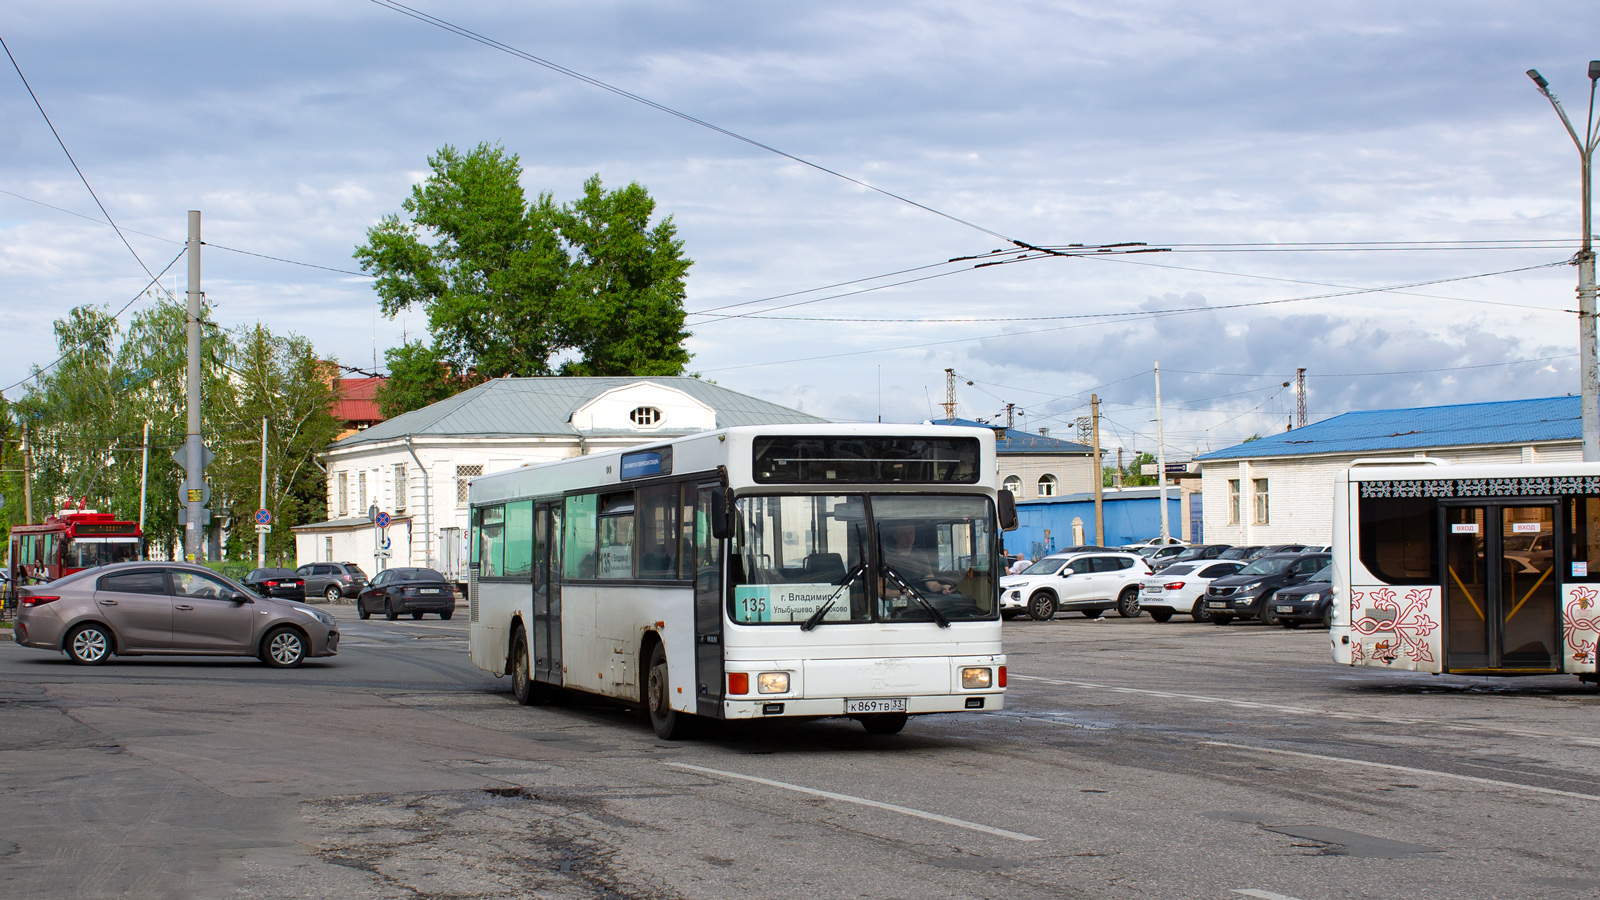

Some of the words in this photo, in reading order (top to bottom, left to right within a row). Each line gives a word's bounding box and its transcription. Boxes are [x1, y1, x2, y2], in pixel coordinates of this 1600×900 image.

[781, 594, 786, 602] г.
[788, 592, 832, 602] Владимир
[741, 598, 766, 612] 135
[773, 606, 815, 614] Улыбышево,
[892, 699, 902, 708] 33
